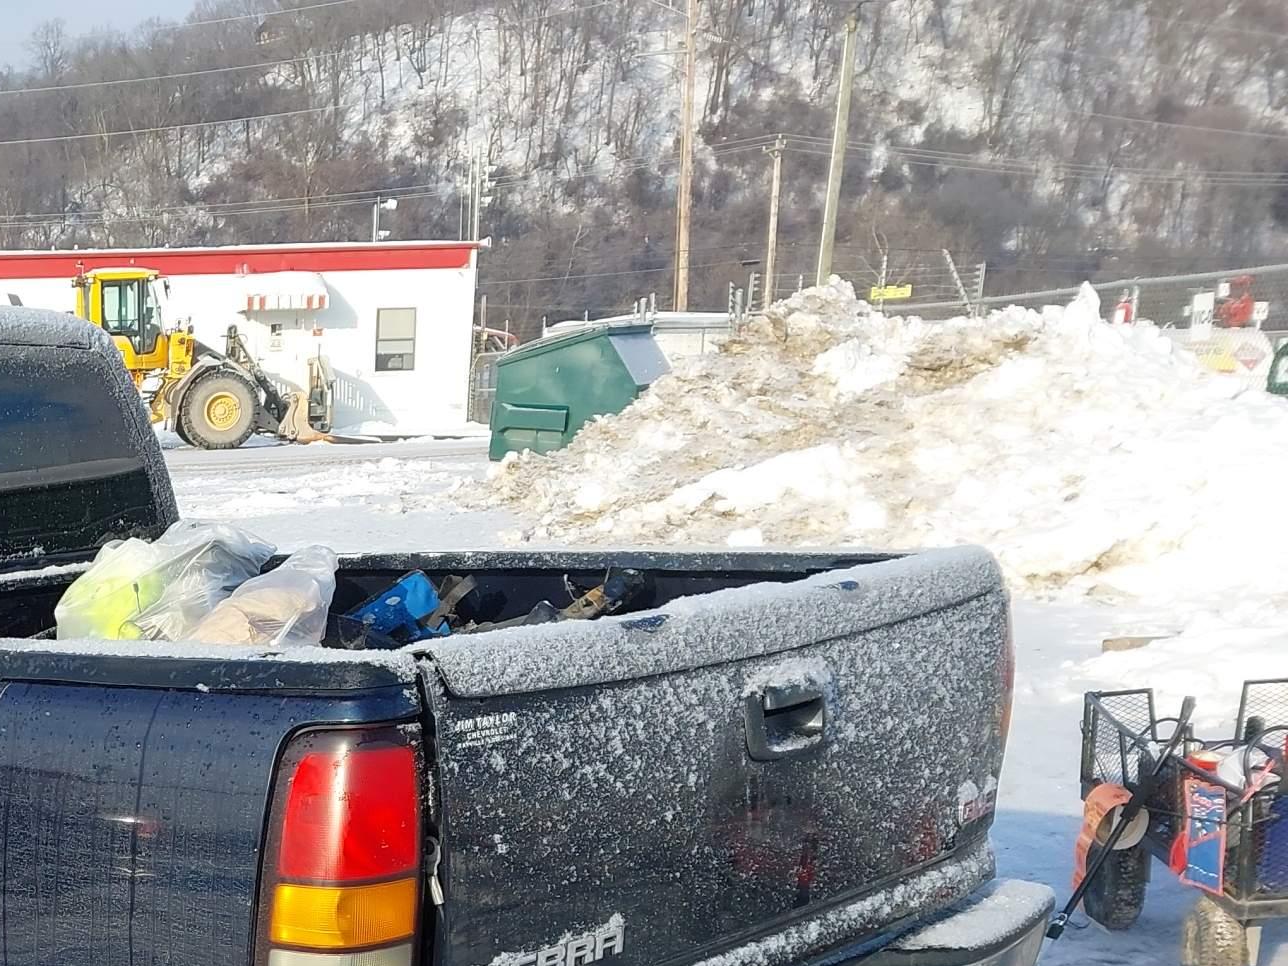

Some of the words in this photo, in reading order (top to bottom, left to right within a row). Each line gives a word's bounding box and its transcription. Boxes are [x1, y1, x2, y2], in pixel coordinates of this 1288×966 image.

[454, 718, 474, 732] JIM
[475, 711, 518, 729] TAYLOR
[466, 726, 509, 740] CHEVROLET
